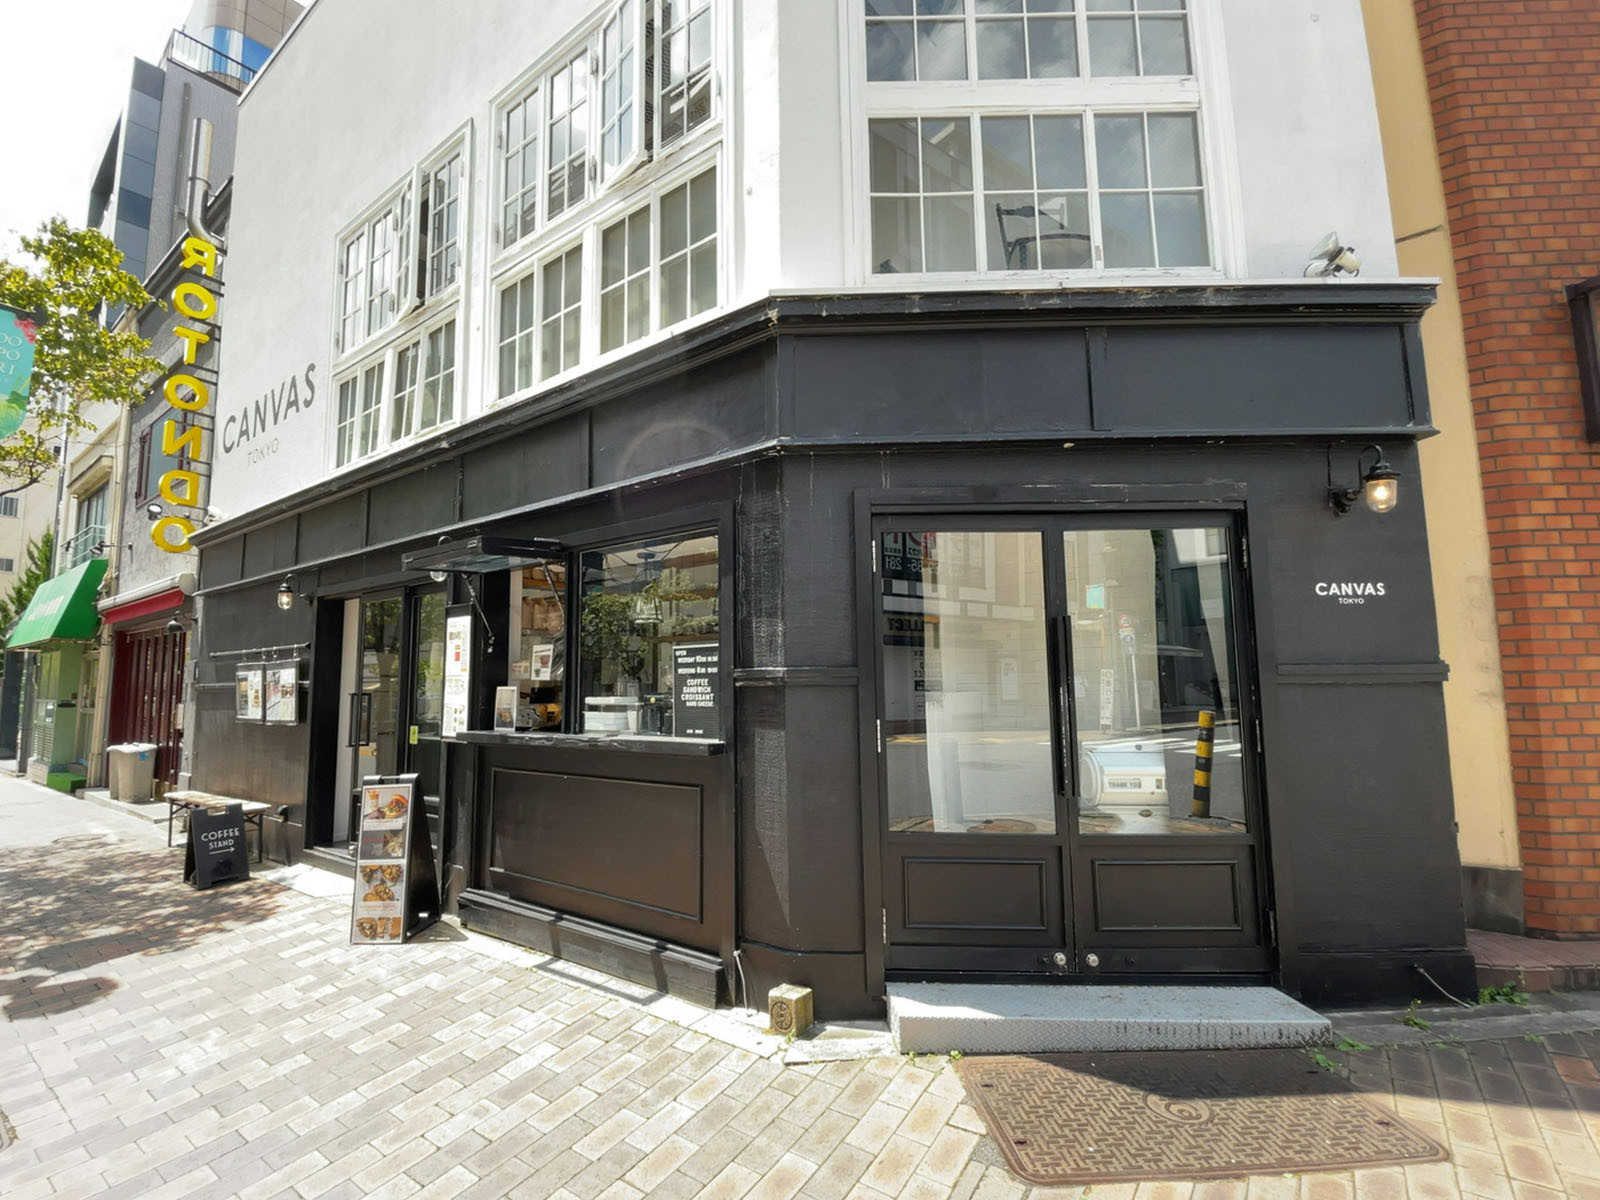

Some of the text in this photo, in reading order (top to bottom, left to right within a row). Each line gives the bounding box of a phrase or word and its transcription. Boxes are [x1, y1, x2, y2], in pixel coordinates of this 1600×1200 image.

[223, 362, 316, 454] CANVAS
[248, 438, 279, 467] TOKYO
[1315, 582, 1386, 596] CANVAS
[1338, 597, 1365, 605] TOKYO
[686, 678, 709, 686] COFFEE
[681, 693, 714, 701] CROISSANT
[201, 828, 240, 841] COFFEE
[209, 839, 234, 849] STAND
